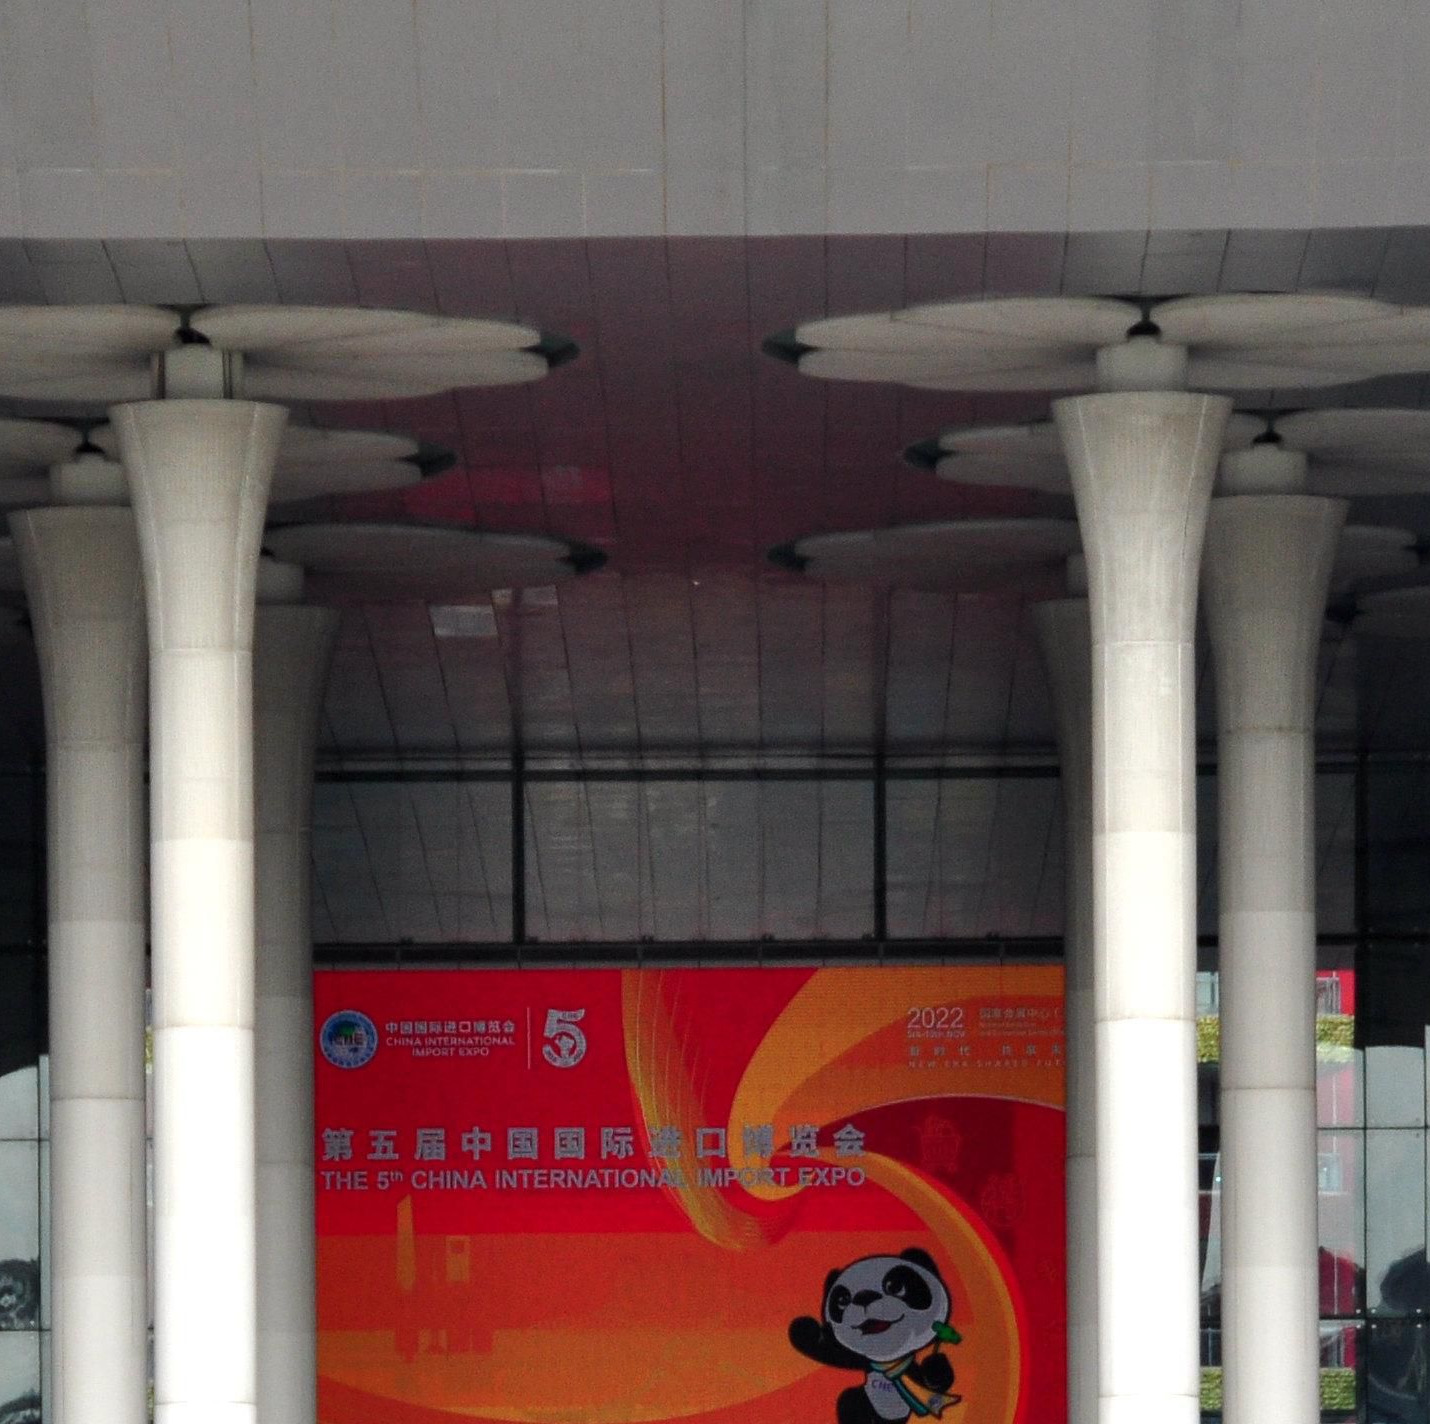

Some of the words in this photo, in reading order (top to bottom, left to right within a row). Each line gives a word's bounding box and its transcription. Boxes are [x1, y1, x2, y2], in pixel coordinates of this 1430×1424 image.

[385, 1020, 515, 1034] 中国国际进口博览会
[907, 1007, 964, 1029] 2022
[386, 1037, 421, 1046] CHINA
[425, 1036, 515, 1046] INTERNATIONAL
[412, 1047, 455, 1057] IMPORT
[459, 1047, 489, 1057] EXPO
[321, 1124, 866, 1162] 第五届中国国际进口博览会
[321, 1170, 369, 1190] THE
[377, 1170, 403, 1190] 5th
[411, 1169, 488, 1189] CHINA
[495, 1168, 687, 1189] INTERNATIONAL
[698, 1167, 791, 1188] IMPORT
[798, 1167, 866, 1187] EXPO
